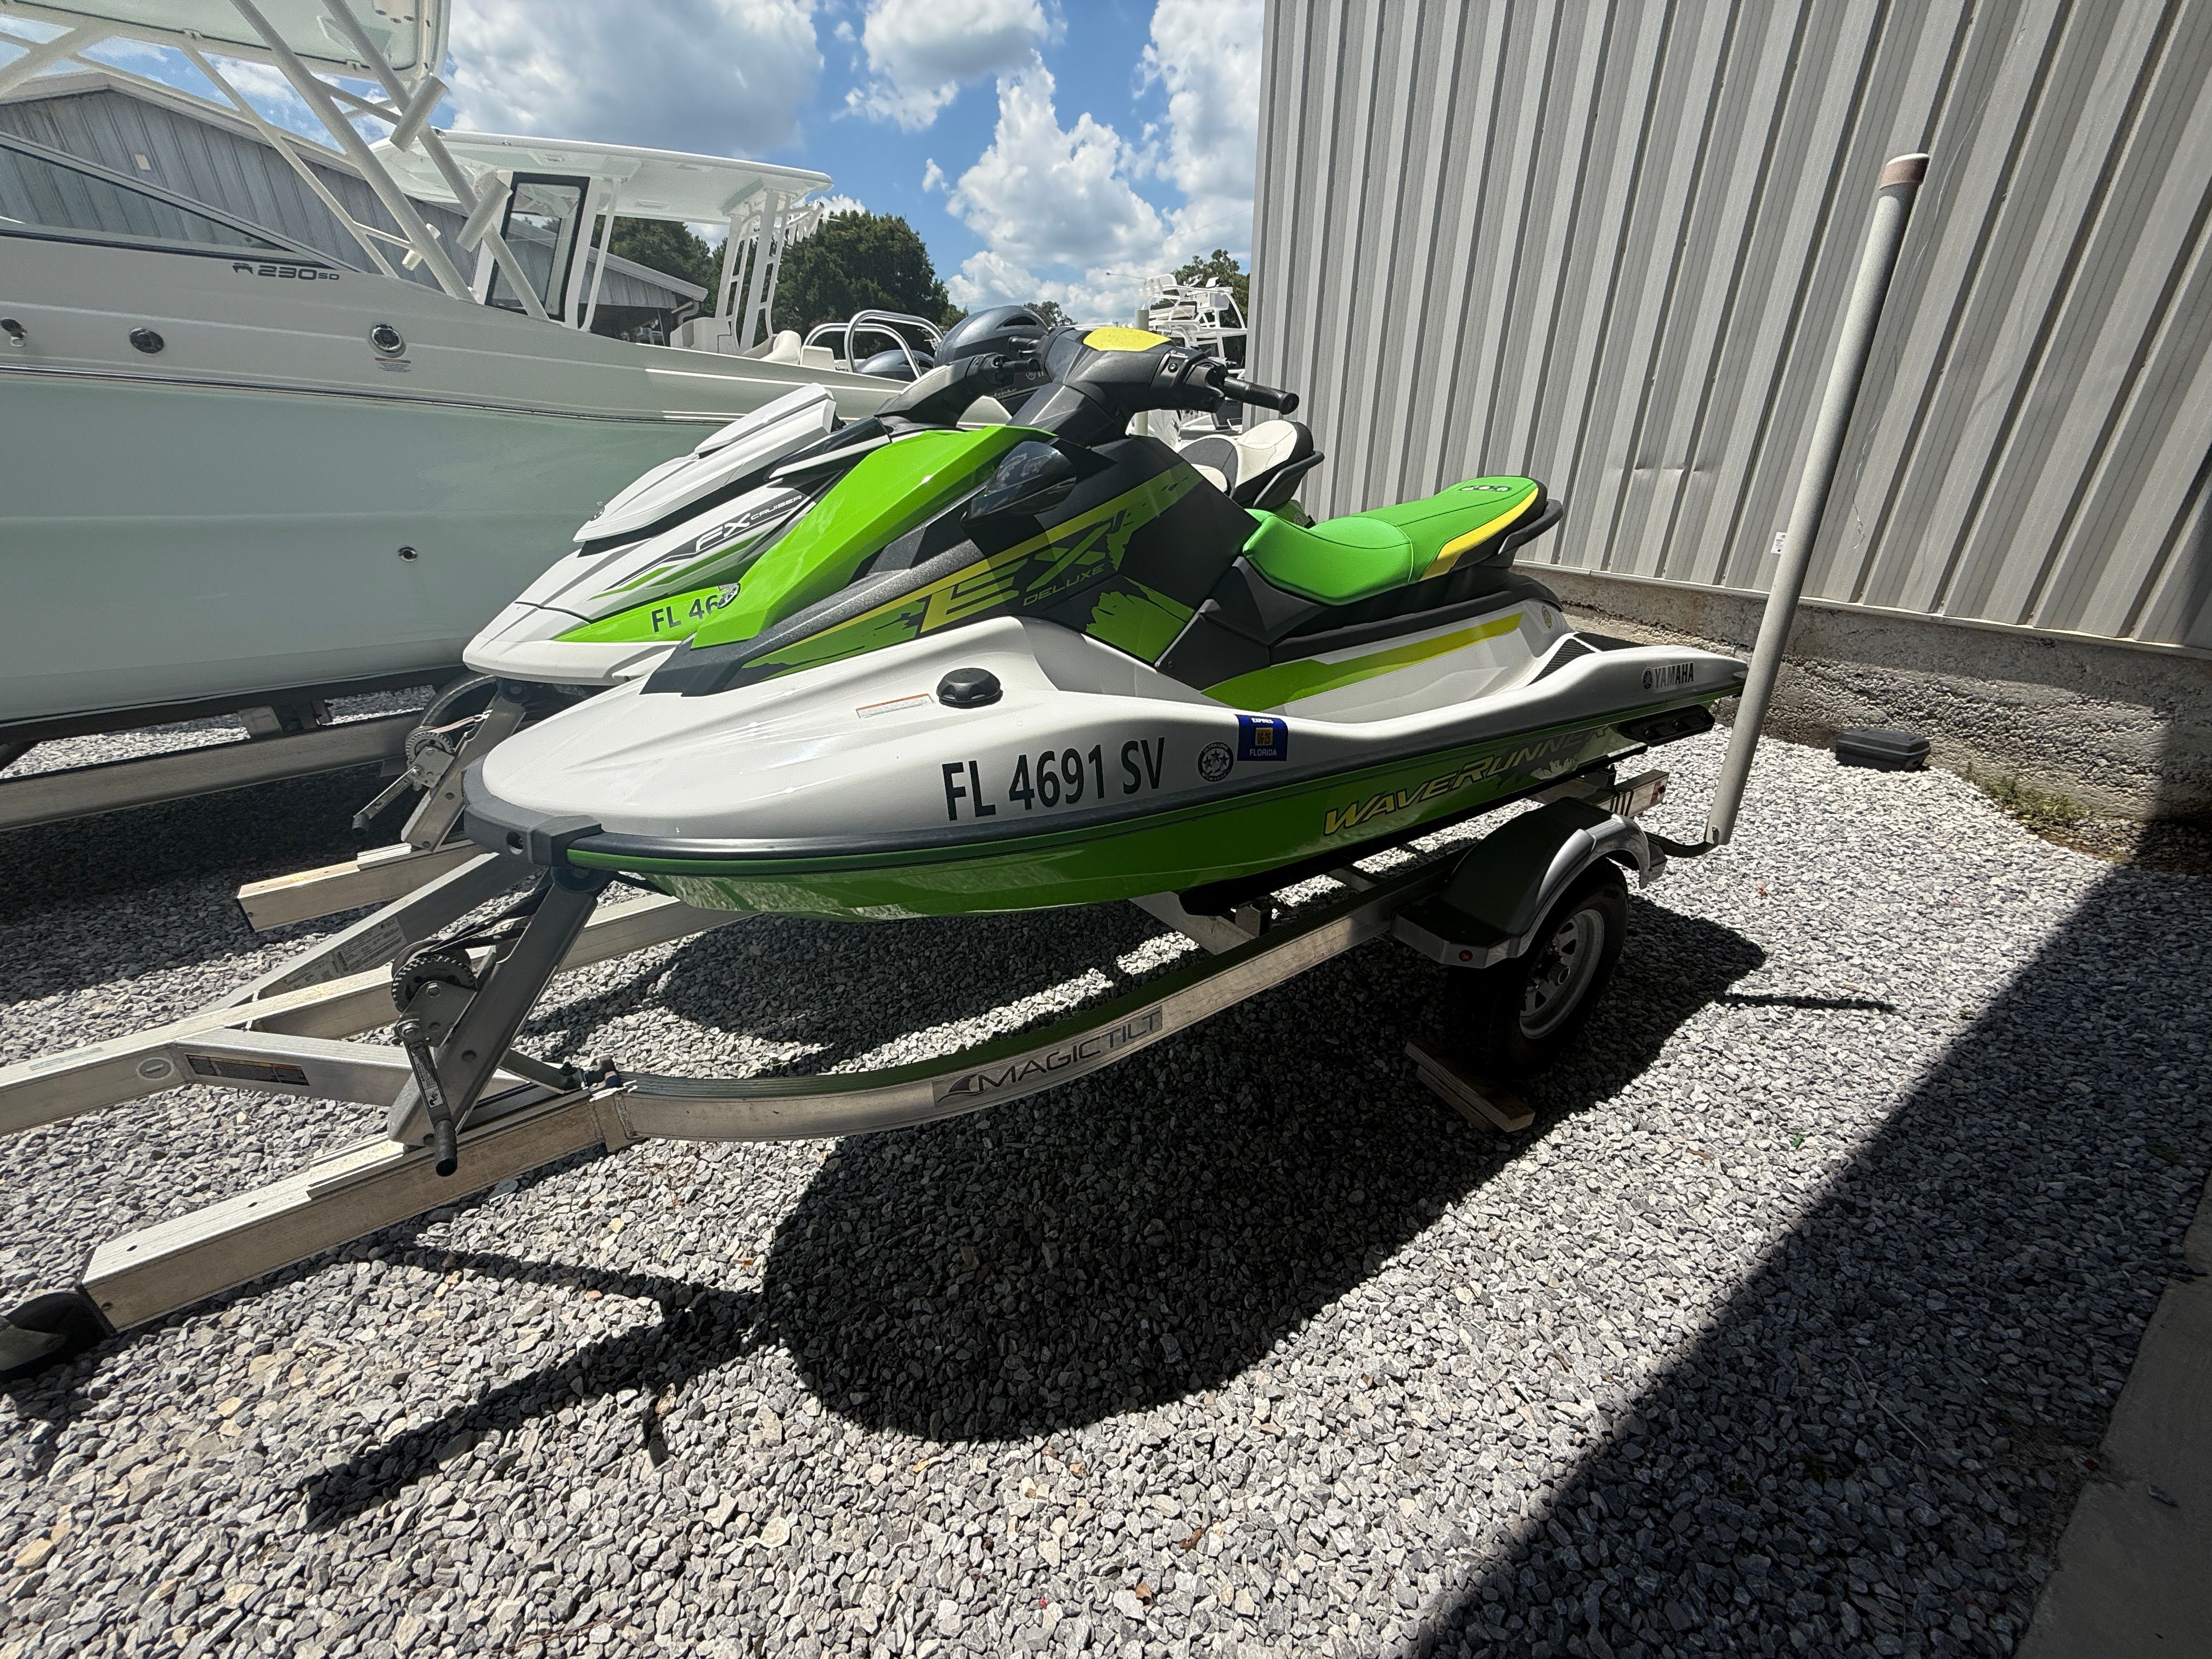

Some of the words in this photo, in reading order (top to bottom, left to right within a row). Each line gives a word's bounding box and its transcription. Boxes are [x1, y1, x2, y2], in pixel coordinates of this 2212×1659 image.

[696, 512, 751, 552] FX
[751, 495, 802, 520] CRUISER
[1023, 563, 1104, 607] DELUXE
[651, 606, 682, 633] FL
[1654, 663, 1694, 689] YAMAHA
[1249, 748, 1277, 757] FLORIDA
[941, 760, 996, 821] FL
[1009, 744, 1104, 810] 4691
[1121, 737, 1165, 794] SV
